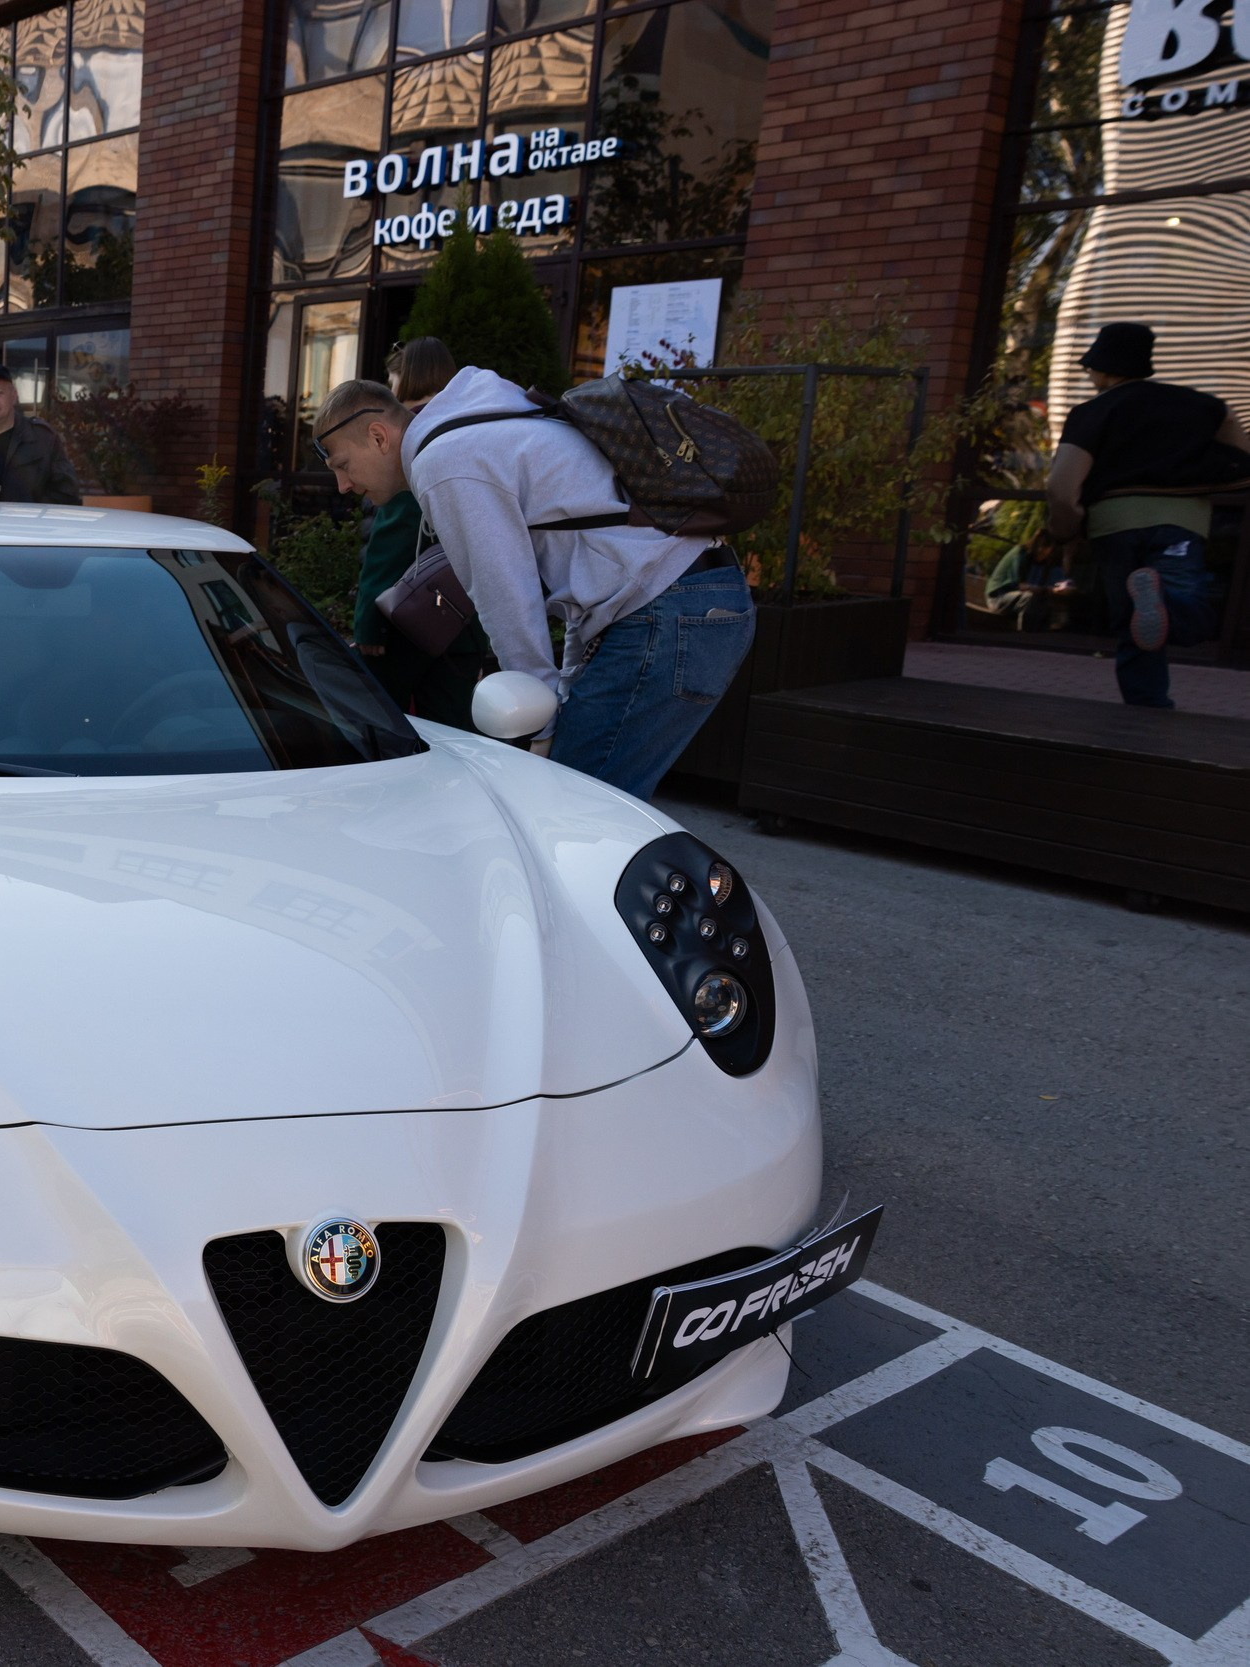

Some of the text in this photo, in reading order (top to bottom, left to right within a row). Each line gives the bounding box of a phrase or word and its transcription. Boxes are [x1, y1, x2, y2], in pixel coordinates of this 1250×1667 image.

[528, 136, 618, 171] октаве
[531, 126, 560, 150] на
[373, 193, 566, 250] кофе и еда
[311, 1224, 375, 1264] ALFA ROMEO
[982, 1426, 1183, 1545] 10
